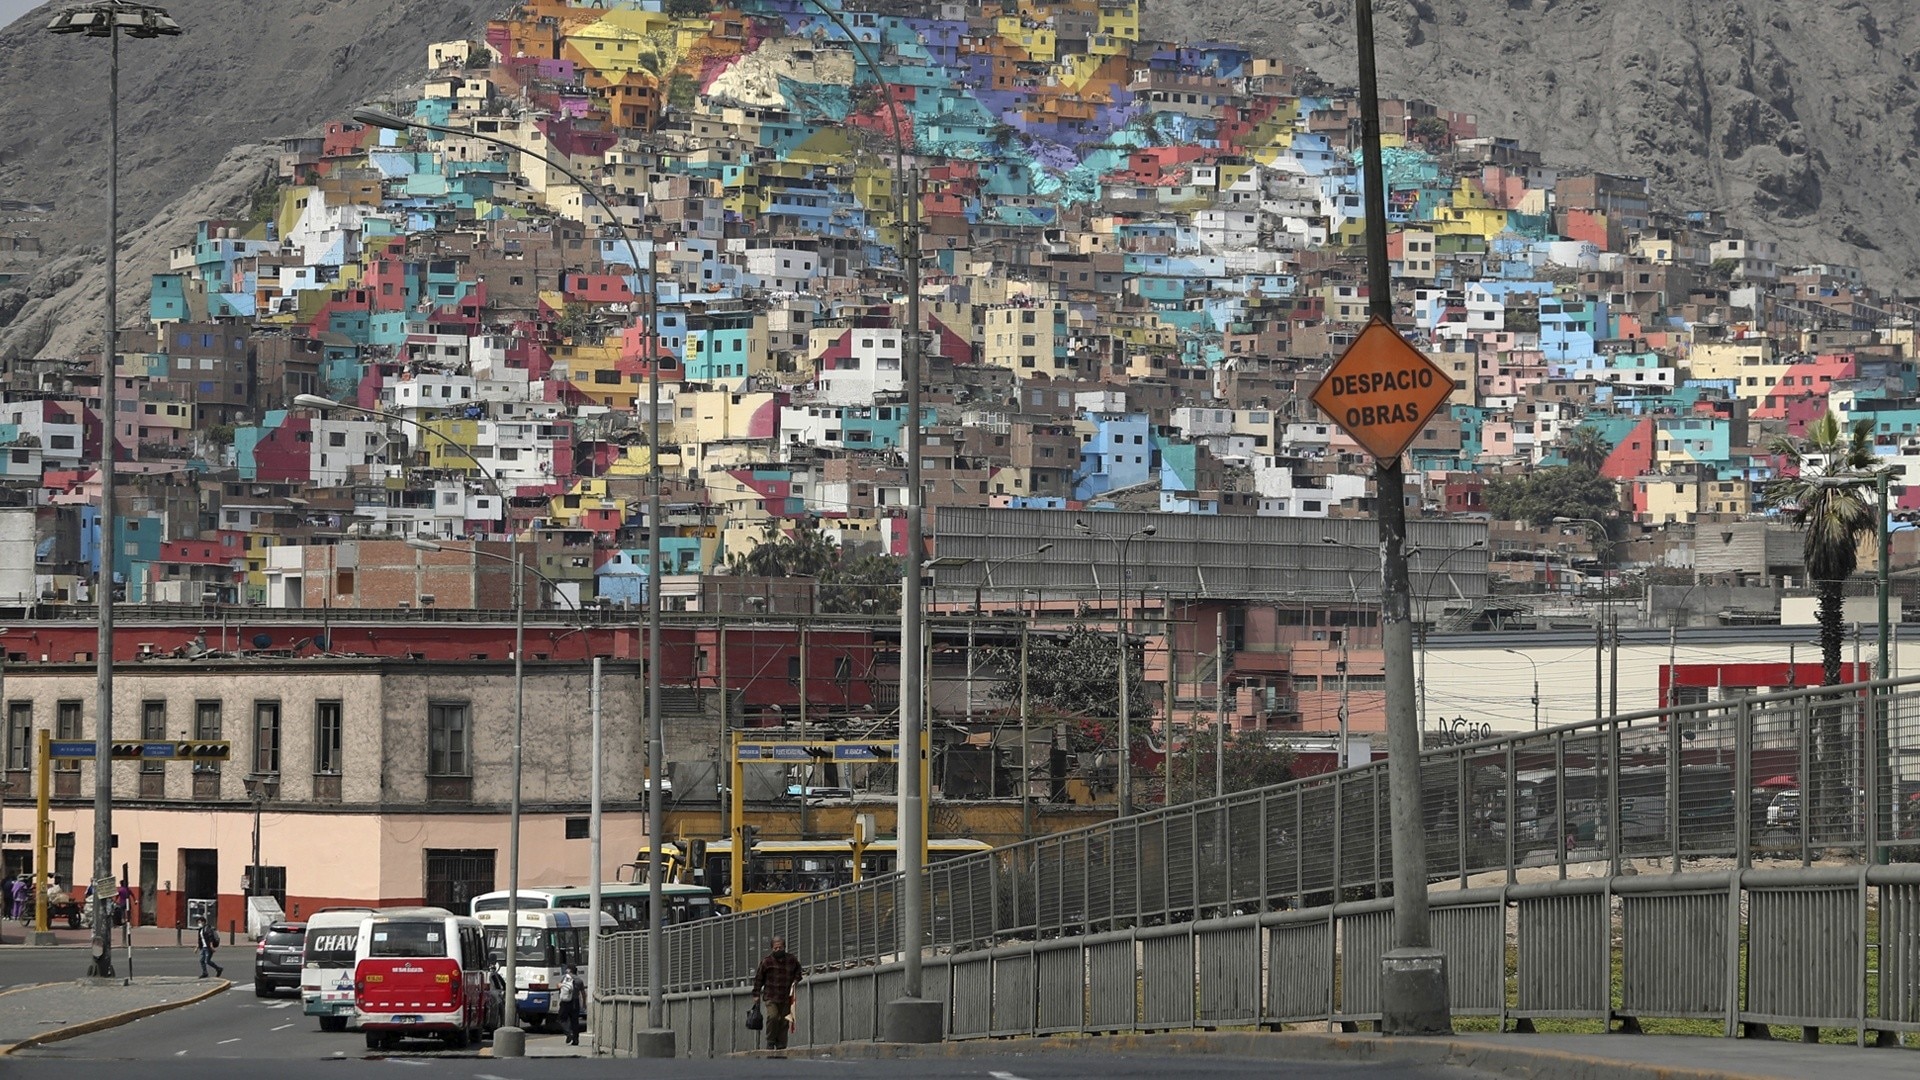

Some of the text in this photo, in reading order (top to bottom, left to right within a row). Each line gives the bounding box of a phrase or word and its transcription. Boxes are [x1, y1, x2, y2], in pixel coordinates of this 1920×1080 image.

[1331, 367, 1433, 396] DESPACIO
[1346, 402, 1419, 428] OBRAS
[1439, 714, 1492, 747] ACHO
